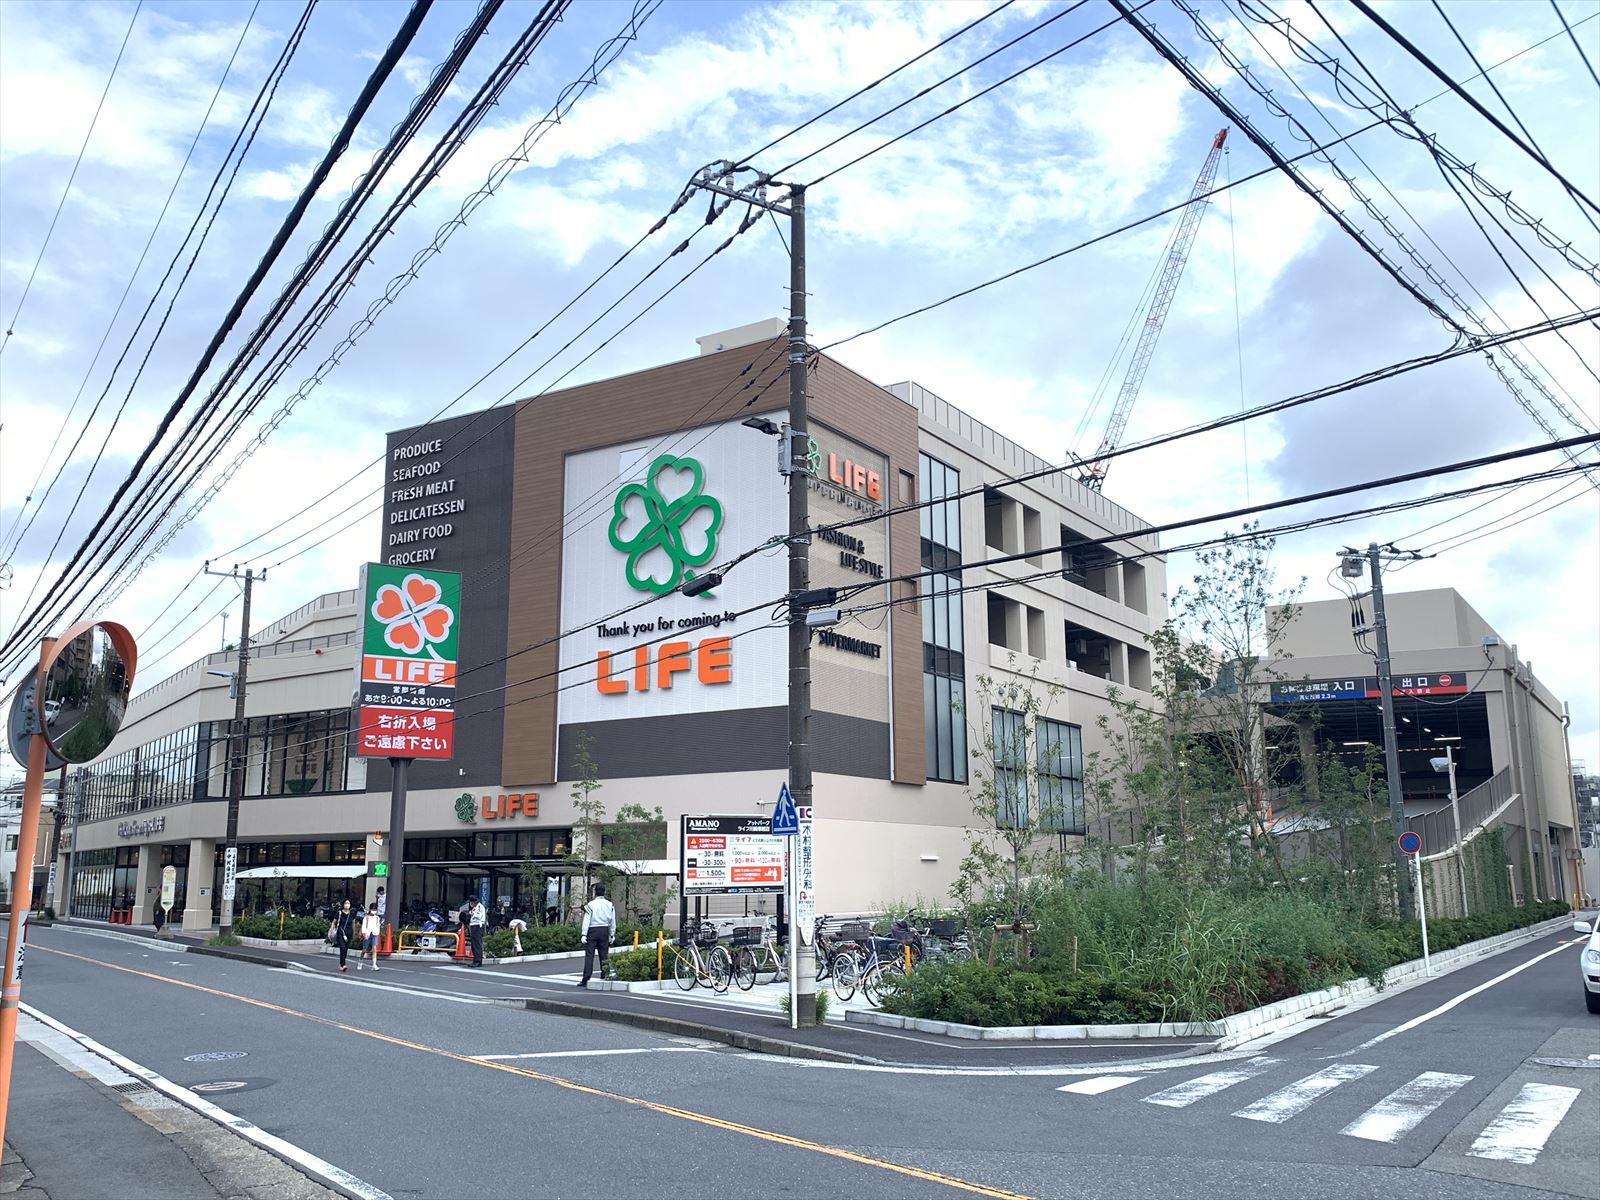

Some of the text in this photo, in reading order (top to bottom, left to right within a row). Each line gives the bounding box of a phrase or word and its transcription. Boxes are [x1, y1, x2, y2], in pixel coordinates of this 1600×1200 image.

[394, 439, 442, 460] PRODUCE
[393, 461, 441, 482] SEAFOOD
[828, 452, 881, 500] LIFE
[391, 479, 455, 503] FRESH MEAT
[390, 499, 465, 525] DELICATESSEN
[389, 523, 453, 546] DAIRY FOOD
[388, 548, 436, 565] GROCERY
[596, 610, 737, 638] Thank you for coming to
[818, 630, 882, 658] SUPERMARKET
[374, 659, 445, 682] LIFE
[597, 636, 732, 694] LIFE
[1333, 681, 1355, 691] 入口
[1402, 677, 1428, 688] 出口
[378, 714, 437, 731] 右折入場
[364, 735, 448, 750] ご遠慮下さい
[482, 792, 540, 819] LIFE
[689, 819, 720, 828] AMANO
